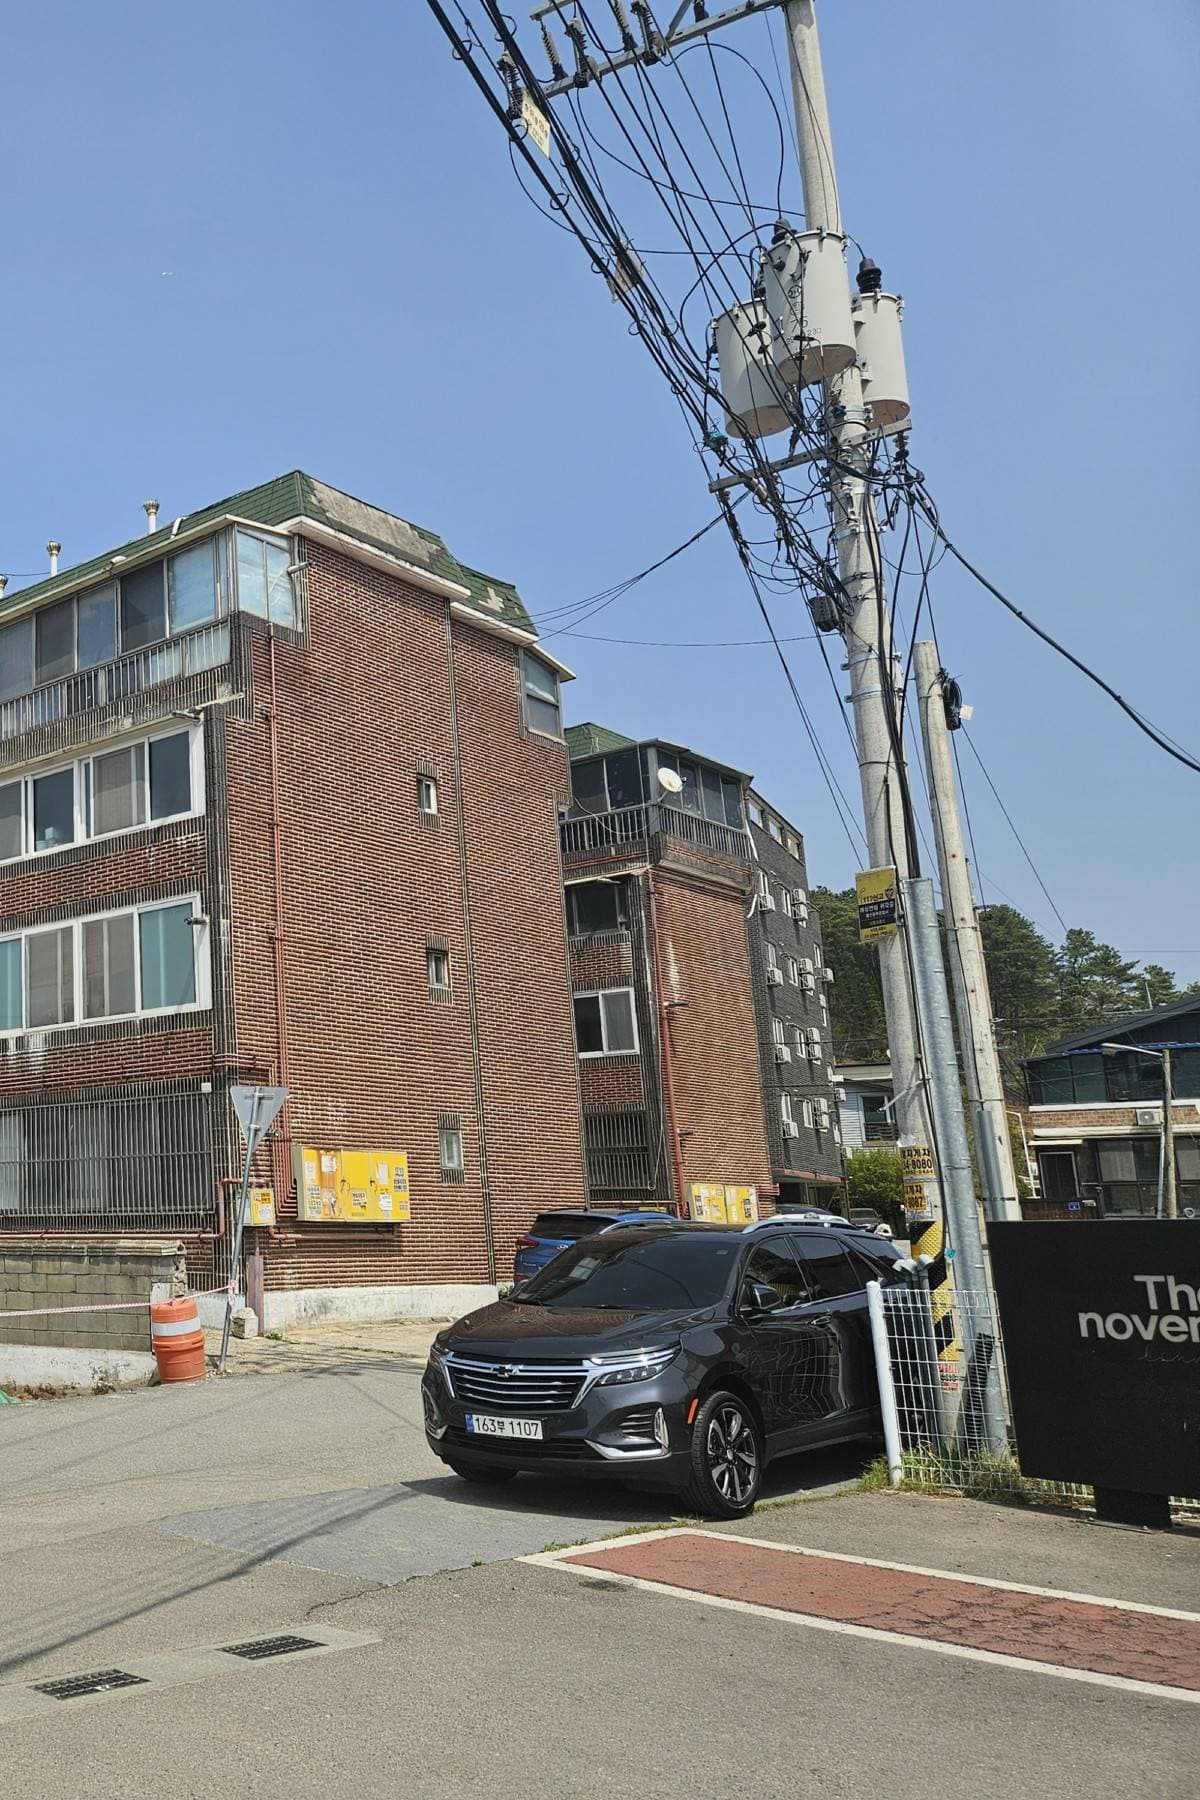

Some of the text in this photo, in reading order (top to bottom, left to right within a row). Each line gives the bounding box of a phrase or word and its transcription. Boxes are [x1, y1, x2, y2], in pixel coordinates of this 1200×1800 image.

[1133, 1274, 1200, 1311] Th
[1078, 1311, 1200, 1343] nove
[509, 1420, 539, 1436] 1107
